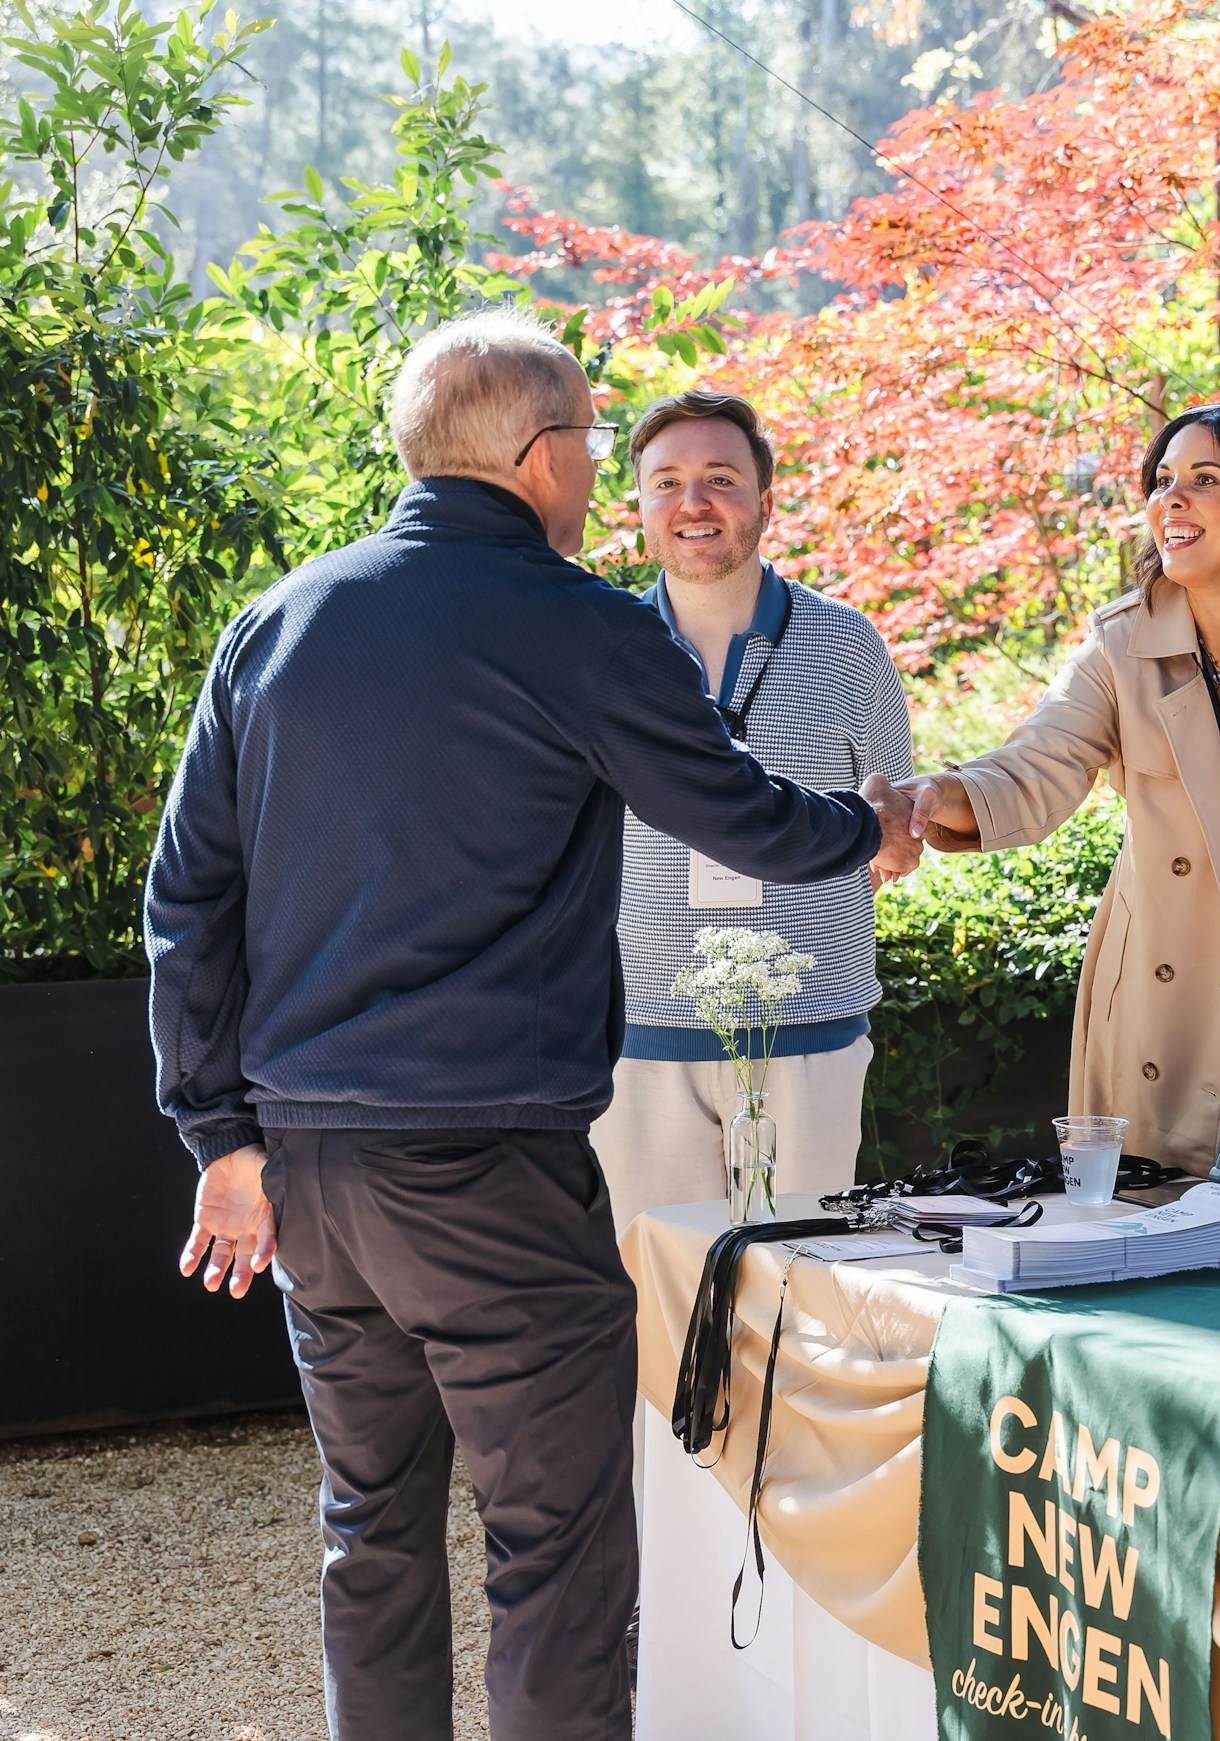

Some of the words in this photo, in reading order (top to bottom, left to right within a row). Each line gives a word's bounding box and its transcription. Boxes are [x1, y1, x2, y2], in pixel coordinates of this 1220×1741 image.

[989, 1395, 1161, 1527] CAMP
[1008, 1490, 1140, 1621] NEW
[951, 1657, 1066, 1735] check-in
[972, 1571, 1172, 1740] ENGEN
